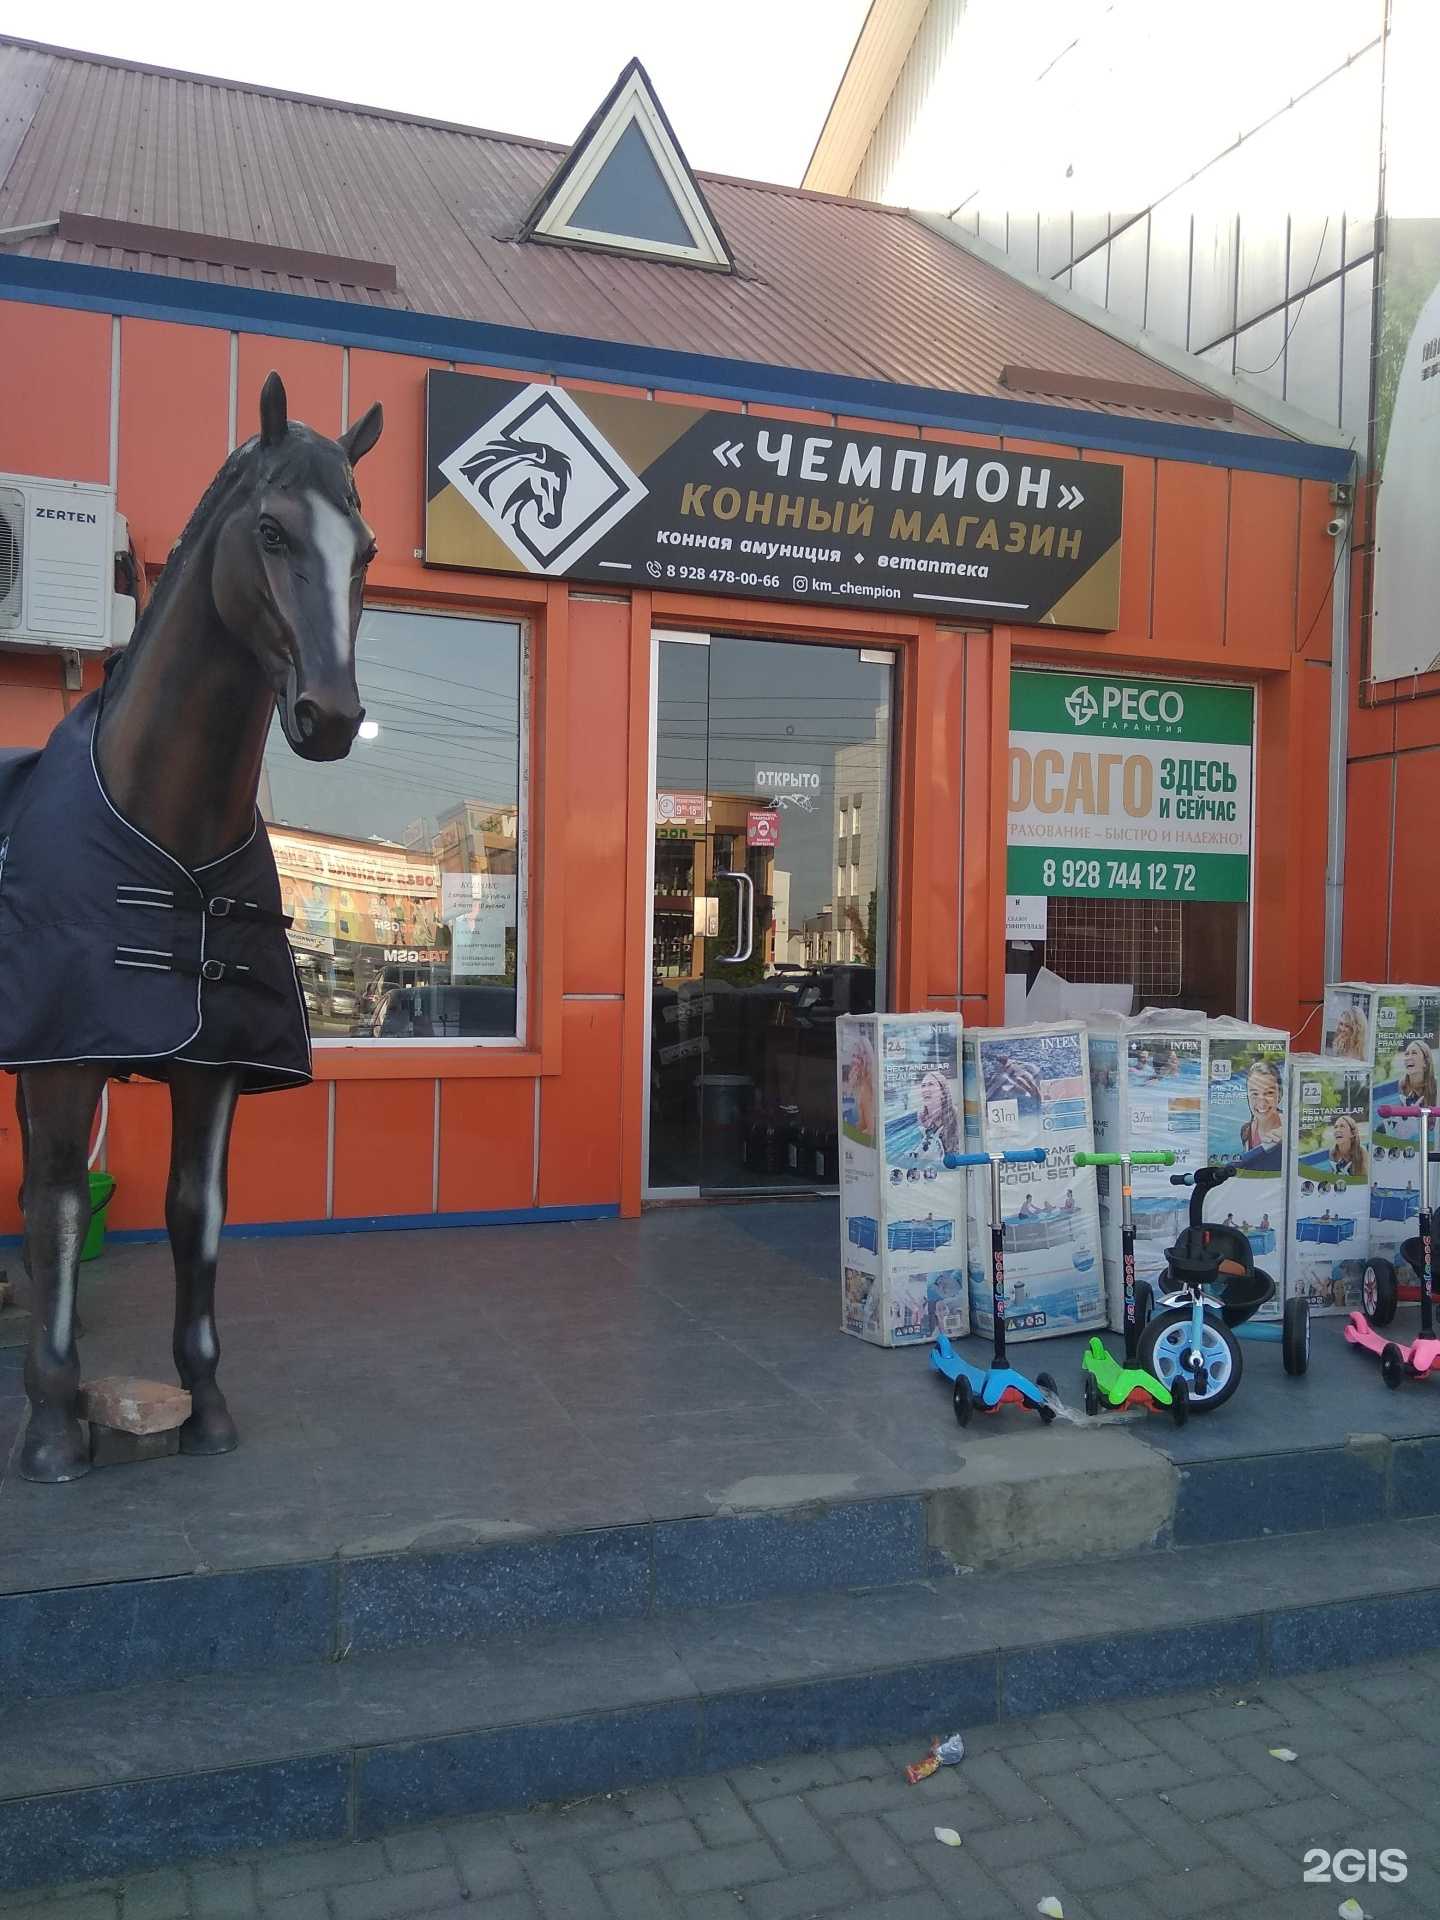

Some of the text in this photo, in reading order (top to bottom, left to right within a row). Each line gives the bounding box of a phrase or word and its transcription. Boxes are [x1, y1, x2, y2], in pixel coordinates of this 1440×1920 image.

[36, 507, 96, 524] ZERTEN
[680, 483, 1083, 560] КОННЫЙ МАГАЗИН
[657, 530, 989, 578] конная амуниция ветаптека
[667, 564, 901, 600] 8 928 478-00-66 km_chempion
[1102, 686, 1185, 723] РЕСО
[1102, 722, 1184, 734] ГАРАНТИЯ
[756, 770, 820, 788] ОТКРЫТО
[1008, 747, 1238, 818] ОСАГО ЗДЕСЬ
[1159, 795, 1236, 822] И СЕЙЧАС
[1008, 824, 1091, 840] РАХОВАНИЕ
[1105, 827, 1158, 843] БЫСТРО
[1161, 829, 1171, 843] И
[1043, 858, 1197, 891] 8 928 744 12 72
[1040, 1035, 1078, 1049] INTEX
[1378, 1032, 1434, 1040] RECTANGULAR
[1170, 1041, 1199, 1051] INTEX
[1256, 1043, 1284, 1051] INTEX
[1302, 1106, 1364, 1116] RECTANGULAR
[1046, 1144, 1076, 1154] RAME
[1047, 1166, 1078, 1180] SET
